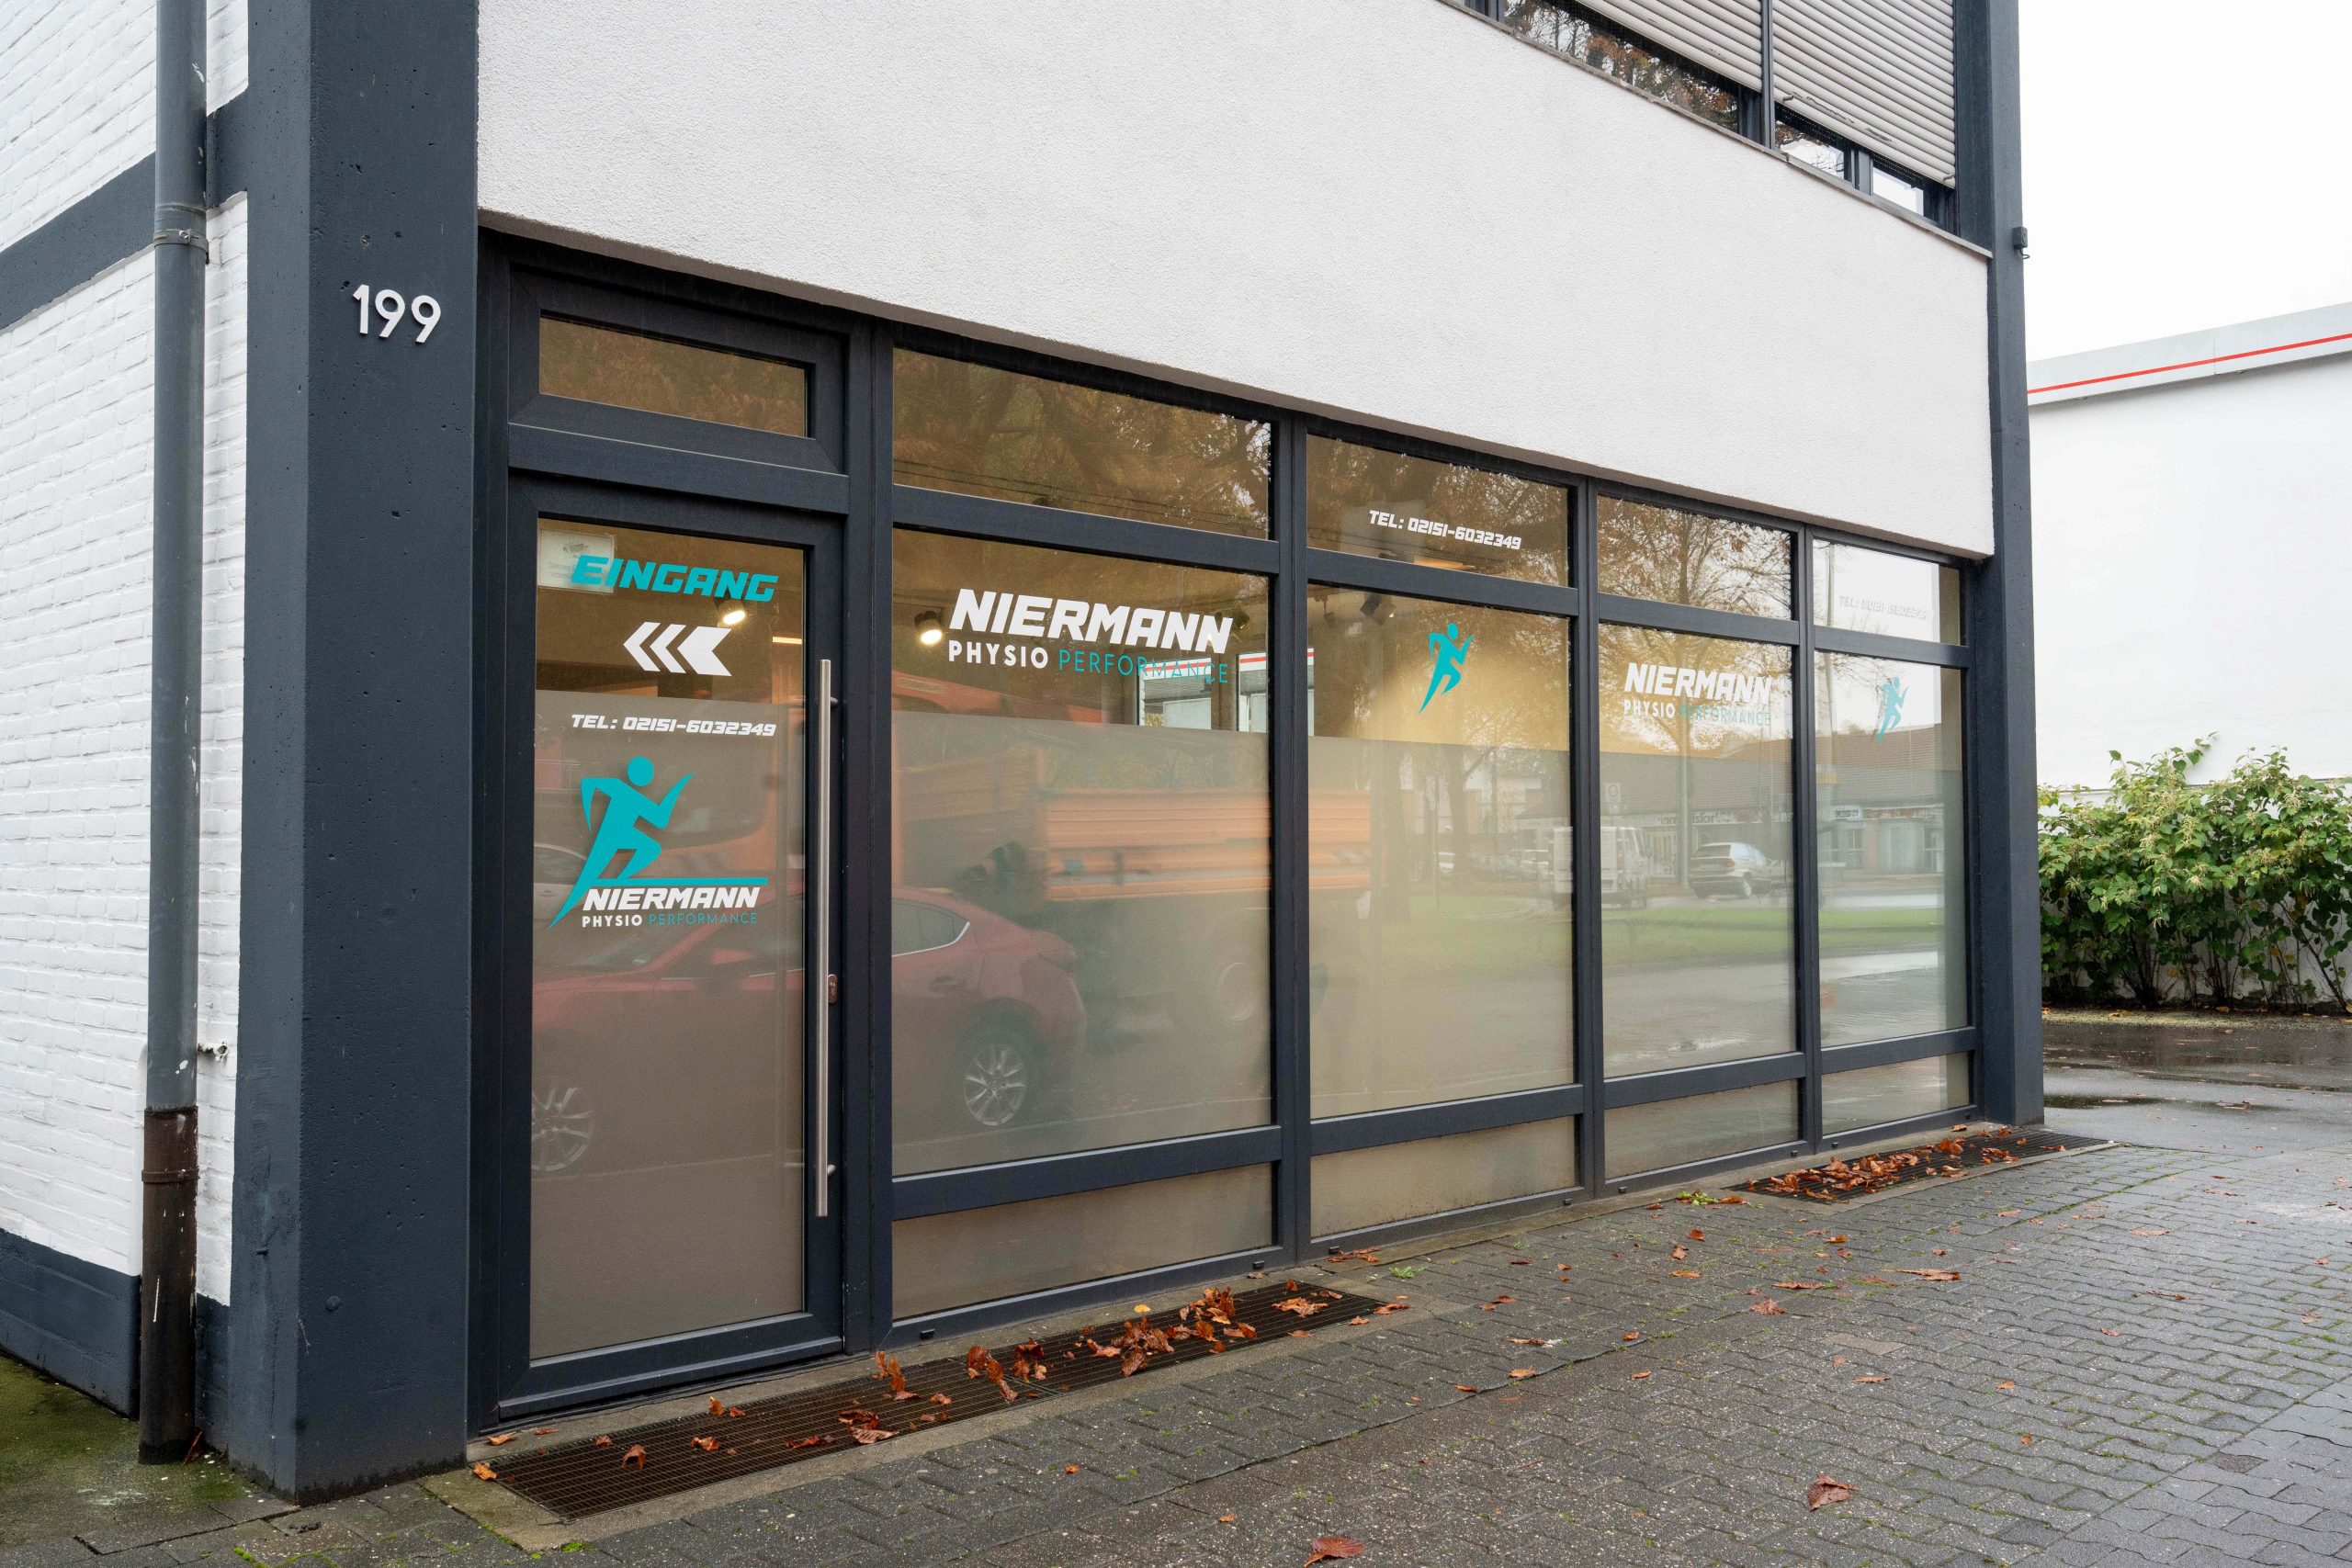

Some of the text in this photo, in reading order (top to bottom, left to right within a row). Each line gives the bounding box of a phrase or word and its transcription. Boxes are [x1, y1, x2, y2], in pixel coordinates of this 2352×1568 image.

[353, 284, 441, 344] 199
[1369, 510, 1522, 550] TEL: 02151-6032349
[571, 554, 779, 602] EINGANG
[949, 588, 1234, 654] NIERMANN
[948, 639, 1228, 683] PHYSIO PERFORMANCE
[1624, 662, 1772, 705] NIERMANN
[571, 714, 777, 737] TEL: 02151-6032349
[1623, 698, 1676, 719] PHYSIO
[582, 886, 761, 911] NIERMANN
[582, 912, 757, 928] PHYSIO PERFORMANCE
